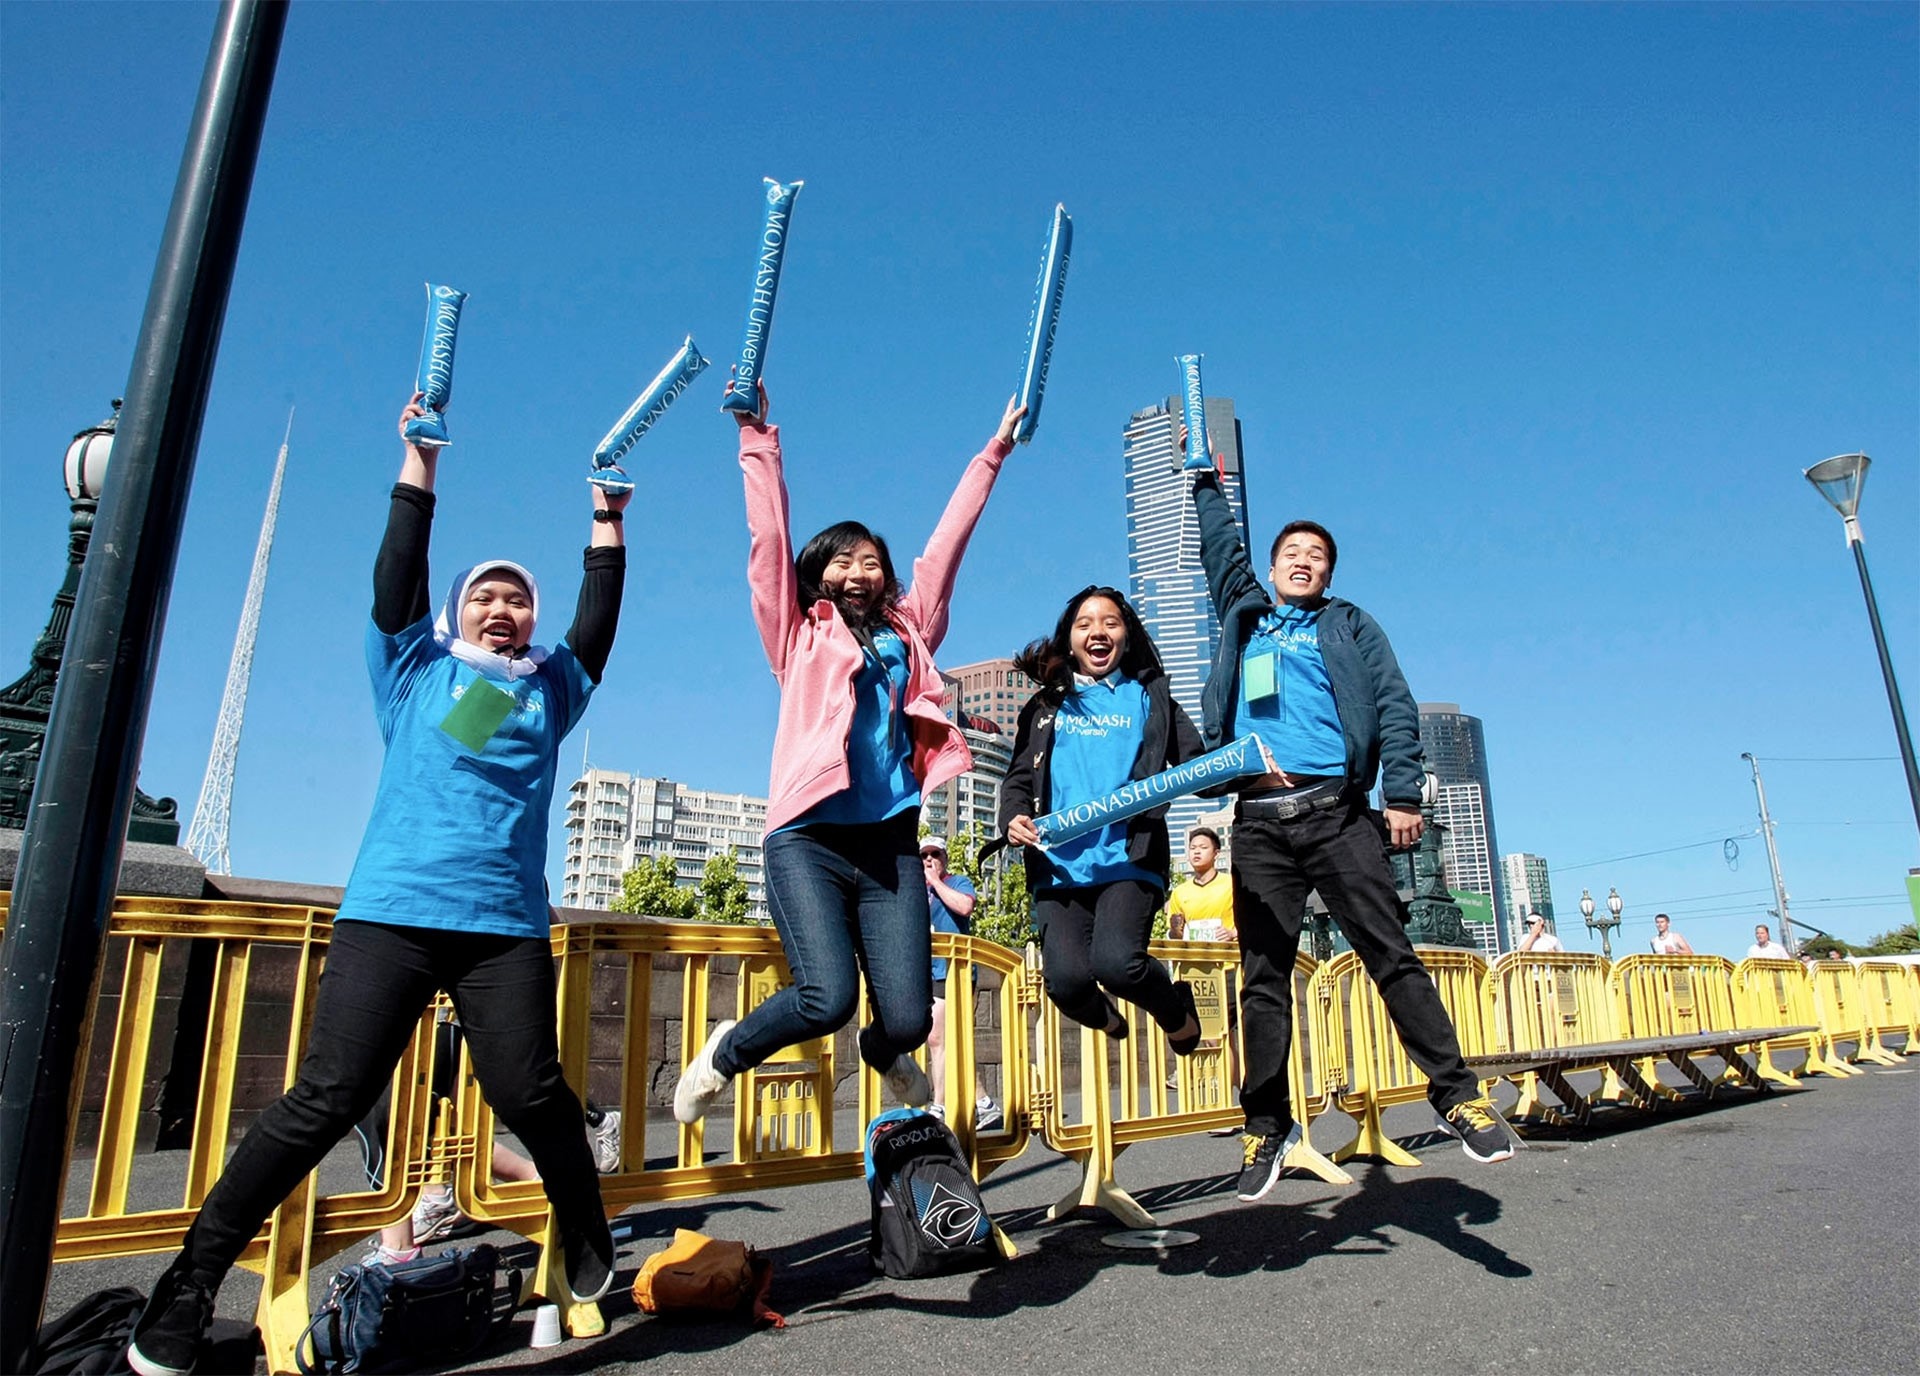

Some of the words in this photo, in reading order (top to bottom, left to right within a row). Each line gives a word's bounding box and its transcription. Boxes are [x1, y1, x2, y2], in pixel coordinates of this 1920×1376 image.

[752, 209, 786, 308] MONASH
[430, 301, 459, 376] MONASH
[734, 306, 769, 399] University
[622, 374, 689, 452] MONASH
[1187, 363, 1203, 410] MONASH
[1190, 410, 1204, 460] University
[1066, 713, 1131, 729] MONASH
[1066, 725, 1109, 738] University
[1056, 782, 1152, 832] MONASH
[1152, 746, 1248, 793] University
[1193, 980, 1217, 997] SEA
